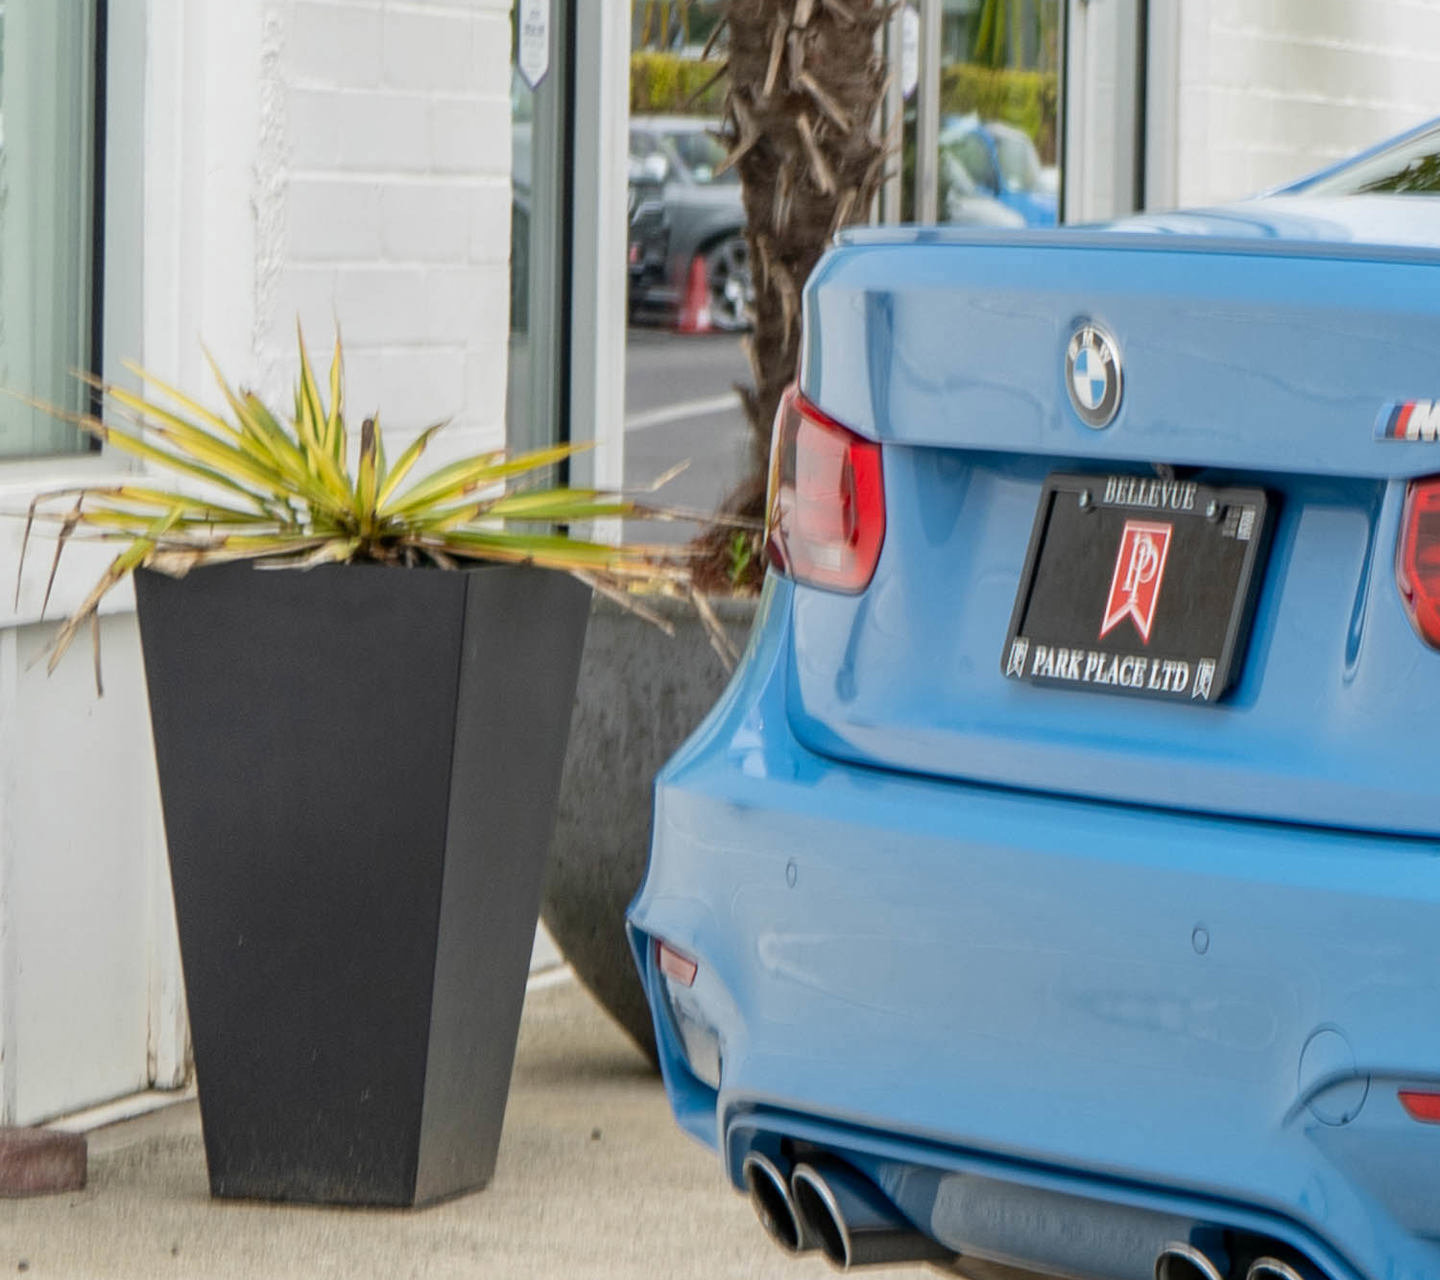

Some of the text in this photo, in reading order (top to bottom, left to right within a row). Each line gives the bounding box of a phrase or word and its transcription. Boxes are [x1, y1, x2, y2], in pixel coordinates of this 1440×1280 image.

[1103, 476, 1198, 510] BELLEVUE
[1031, 645, 1085, 680] PARK
[1084, 650, 1148, 688] PLACE
[1149, 657, 1189, 693] LTD
